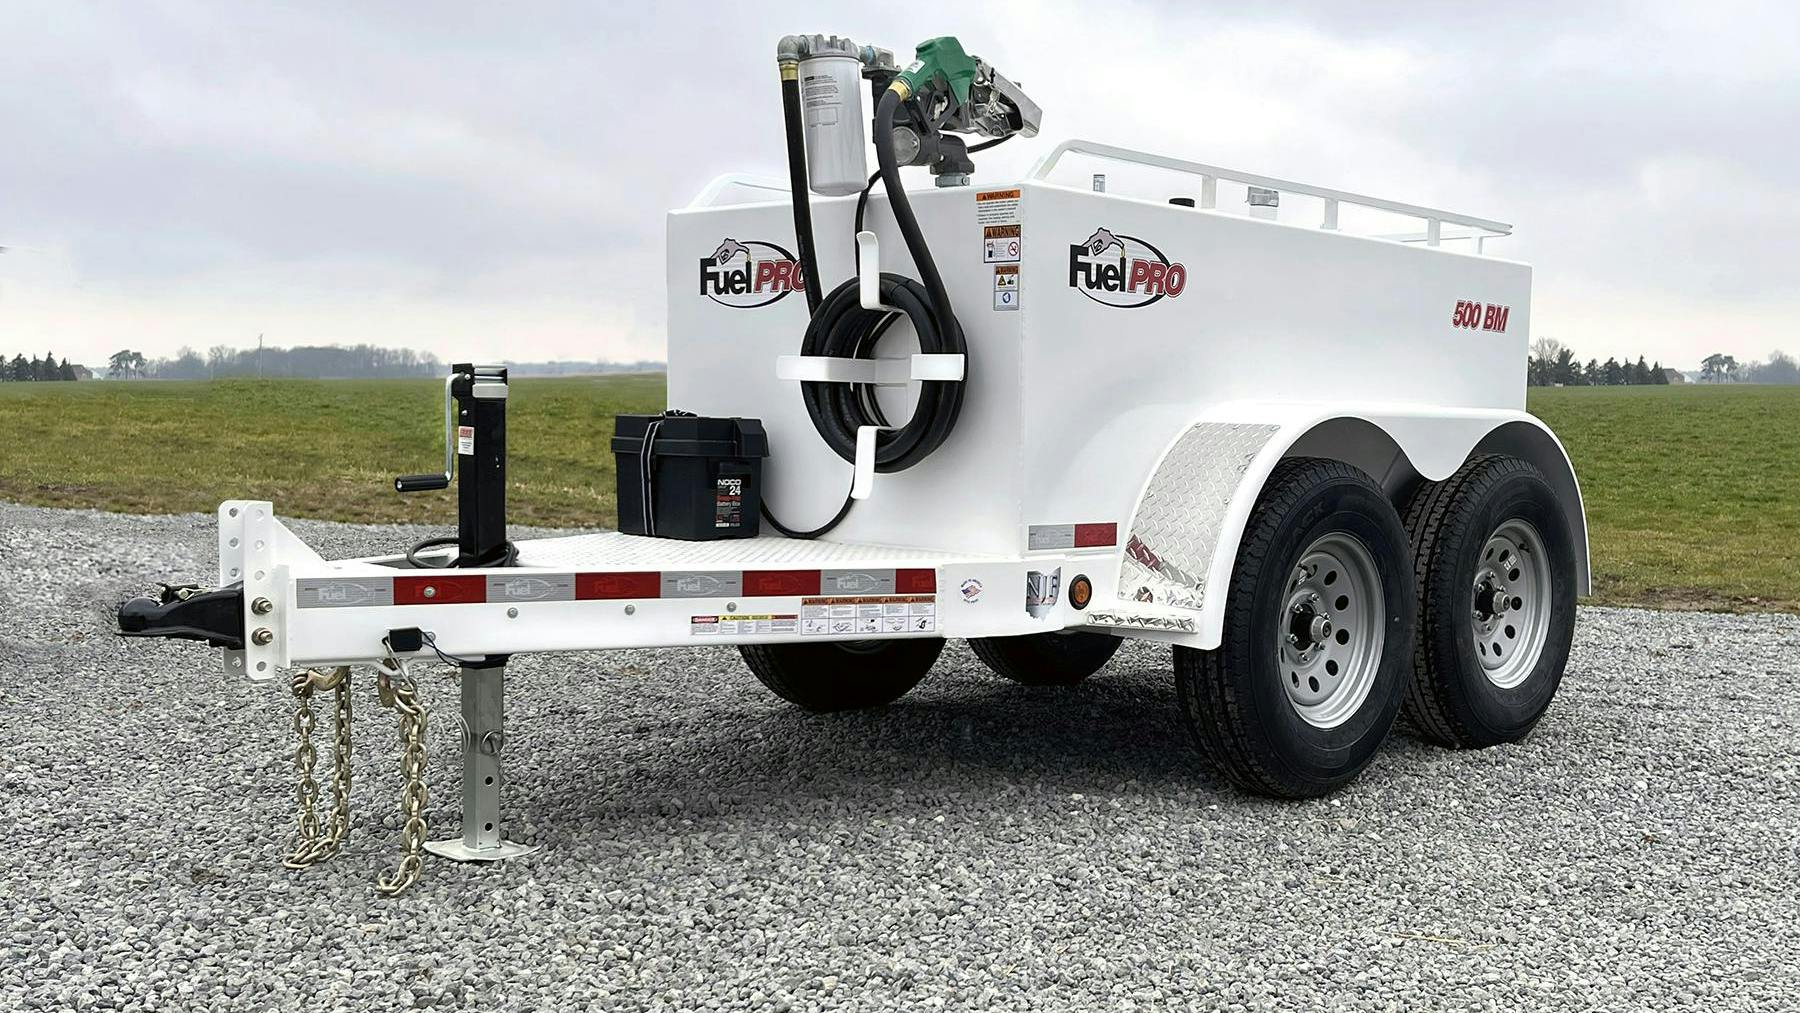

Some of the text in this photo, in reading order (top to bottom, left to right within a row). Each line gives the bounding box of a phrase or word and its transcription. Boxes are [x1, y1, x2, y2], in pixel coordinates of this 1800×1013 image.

[1453, 300, 1509, 332] 500 BM
[729, 486, 741, 496] 24
